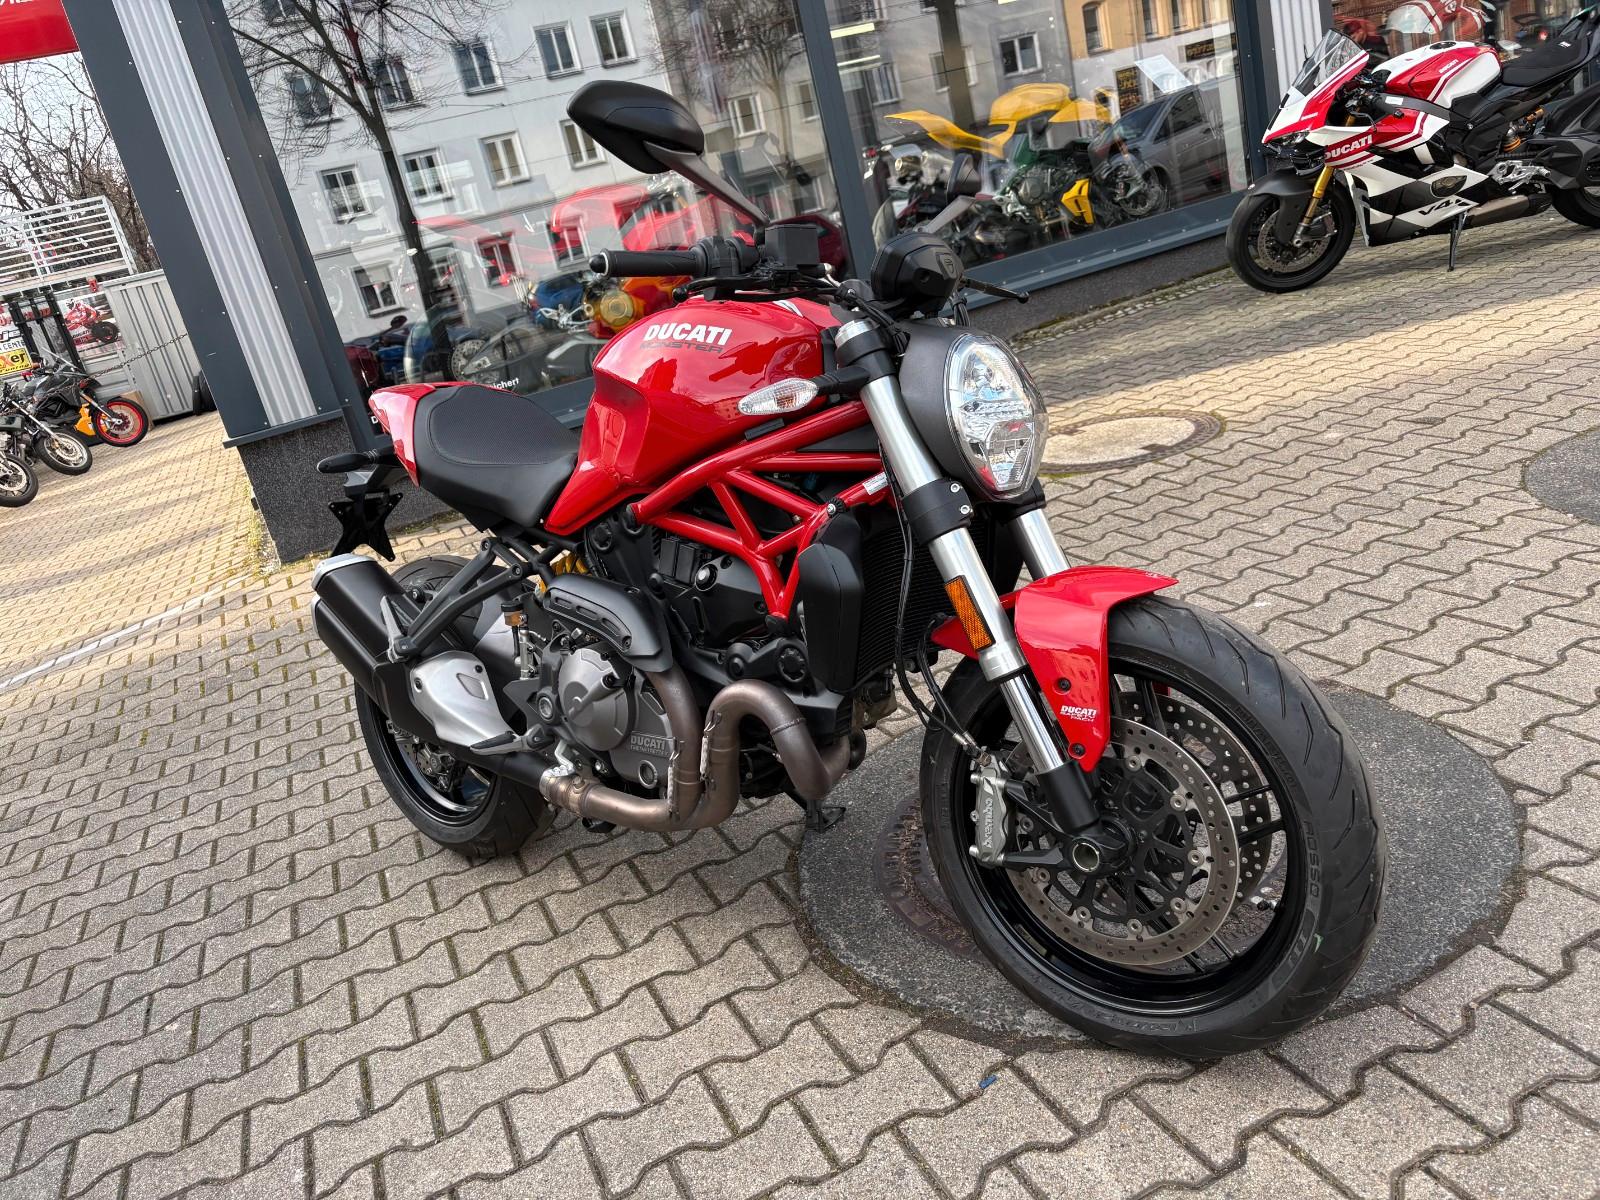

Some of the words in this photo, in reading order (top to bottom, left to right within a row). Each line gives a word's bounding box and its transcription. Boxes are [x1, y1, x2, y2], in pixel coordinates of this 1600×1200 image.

[1325, 134, 1373, 159] DUCATI
[643, 322, 733, 346] DUCATI
[3, 340, 25, 351] CENTE
[1060, 705, 1097, 716] DUCATI
[631, 735, 666, 750] DUCATI
[983, 798, 993, 849] brembo
